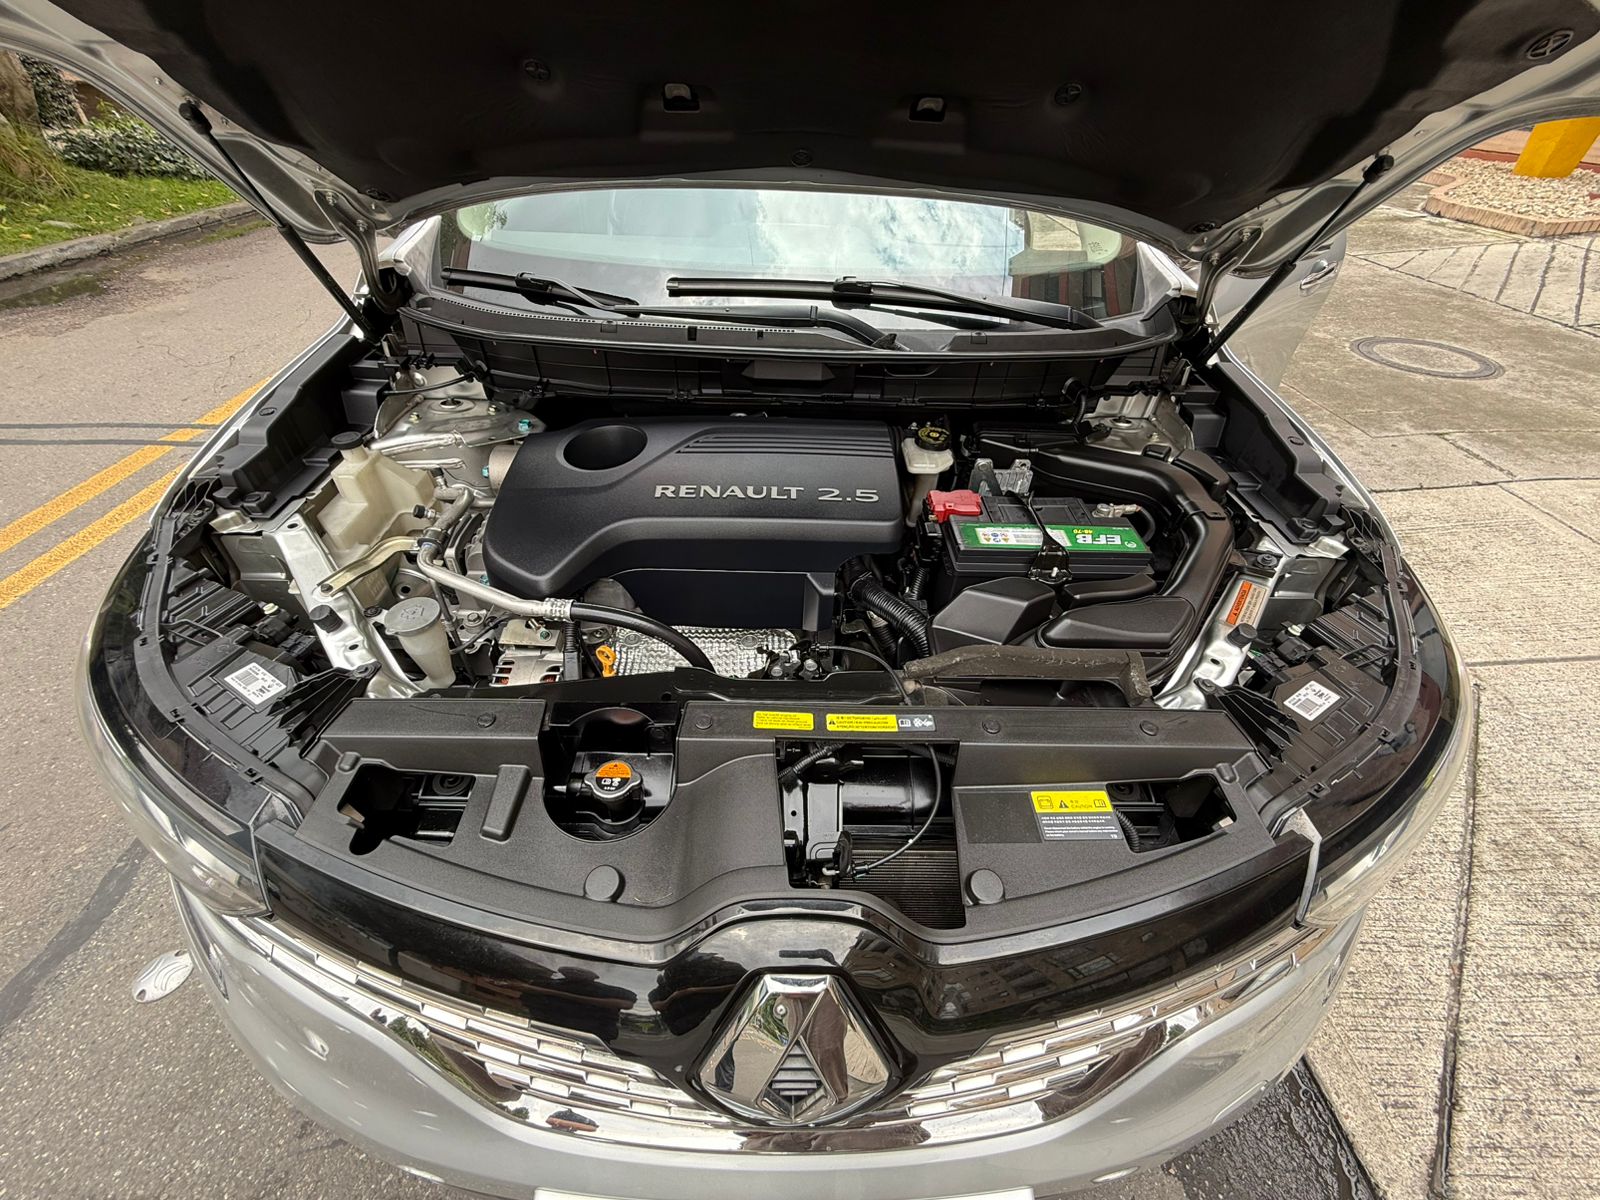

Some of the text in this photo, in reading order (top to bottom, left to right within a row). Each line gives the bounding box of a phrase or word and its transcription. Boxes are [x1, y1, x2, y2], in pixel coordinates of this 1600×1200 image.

[654, 484, 880, 503] RENAULT 2.5
[1076, 534, 1122, 545] EFB
